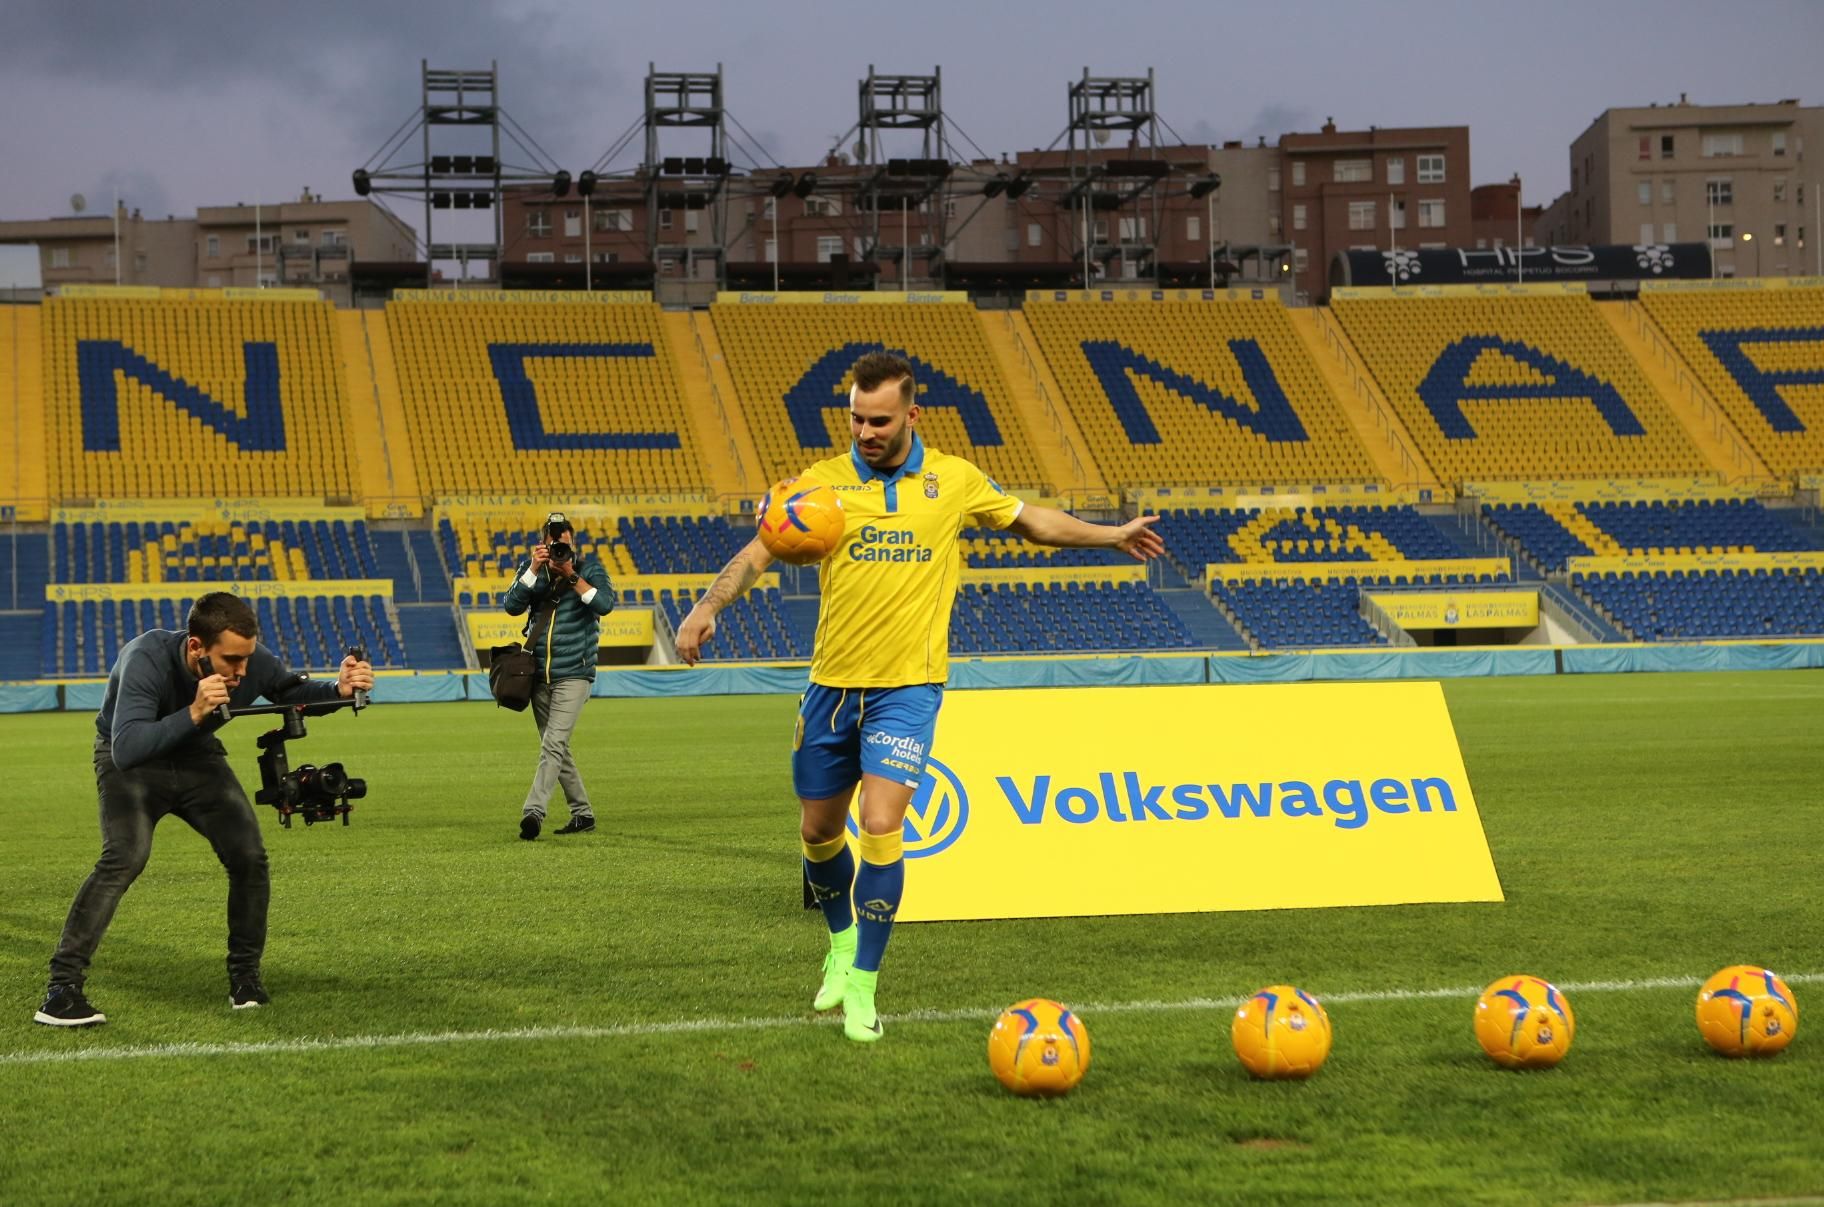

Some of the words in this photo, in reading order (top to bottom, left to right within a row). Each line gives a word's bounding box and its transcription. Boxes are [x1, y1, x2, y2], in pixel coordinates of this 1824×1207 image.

[1457, 246, 1595, 267] HPS
[1463, 268, 1503, 276] HOSPITAL
[1555, 265, 1598, 274] SOCORRO
[740, 292, 777, 303] Binter
[823, 292, 860, 303] Binter
[906, 292, 944, 303] Binter
[861, 526, 914, 545] Gran
[849, 542, 932, 562] Canaria
[68, 586, 113, 599] HPS
[243, 583, 286, 595] HPS
[891, 746, 921, 765] hotels
[995, 771, 1458, 829] Volkswagen
